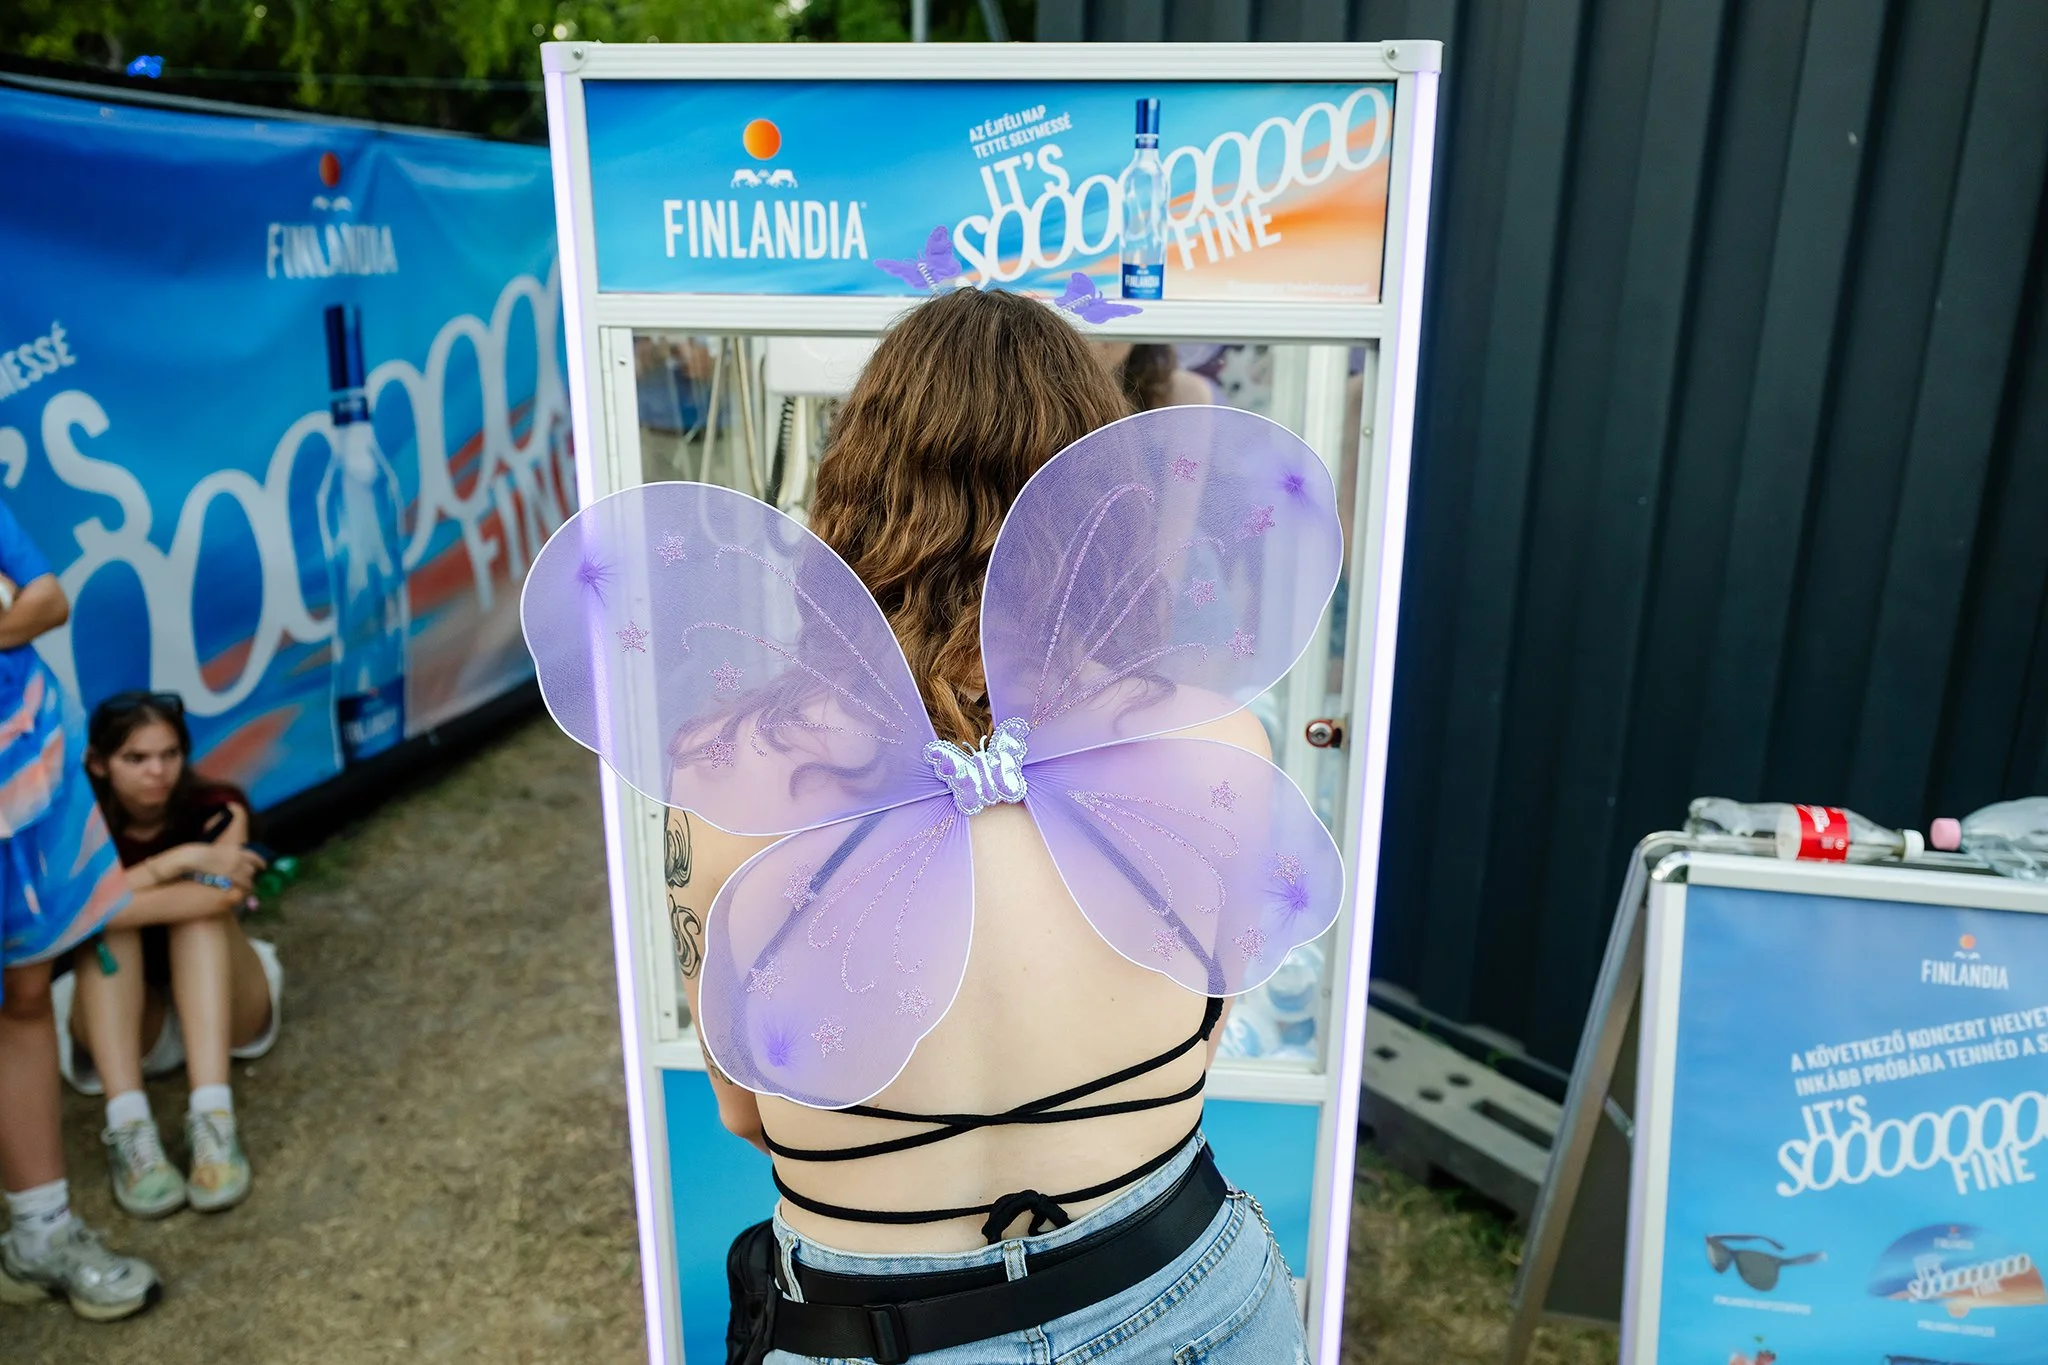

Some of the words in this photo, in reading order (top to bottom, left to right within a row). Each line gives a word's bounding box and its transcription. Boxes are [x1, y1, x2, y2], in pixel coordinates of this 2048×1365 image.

[969, 125, 986, 143] AZ
[1021, 104, 1047, 125] NAP
[972, 136, 1011, 159] TETTE
[267, 222, 399, 279] FINLANDIA
[663, 199, 868, 259] FINLANDIA
[1172, 199, 1283, 272] FINE
[1920, 958, 2010, 991] FINLANDIA
[1791, 1053, 1804, 1073] A
[1804, 1028, 1906, 1071] KÖVETKEZŐ
[1906, 1017, 1986, 1050] KONCERT
[1989, 1005, 2048, 1035] HELYE
[1795, 1064, 1862, 1097] INKÁBB
[1862, 1051, 1946, 1085] PRÓBÁRA
[1946, 1036, 2019, 1069] TENNÉD
[2022, 1036, 2037, 1057] A
[1801, 1094, 1872, 1140] IT'S
[1950, 1144, 2036, 1196] FINE
